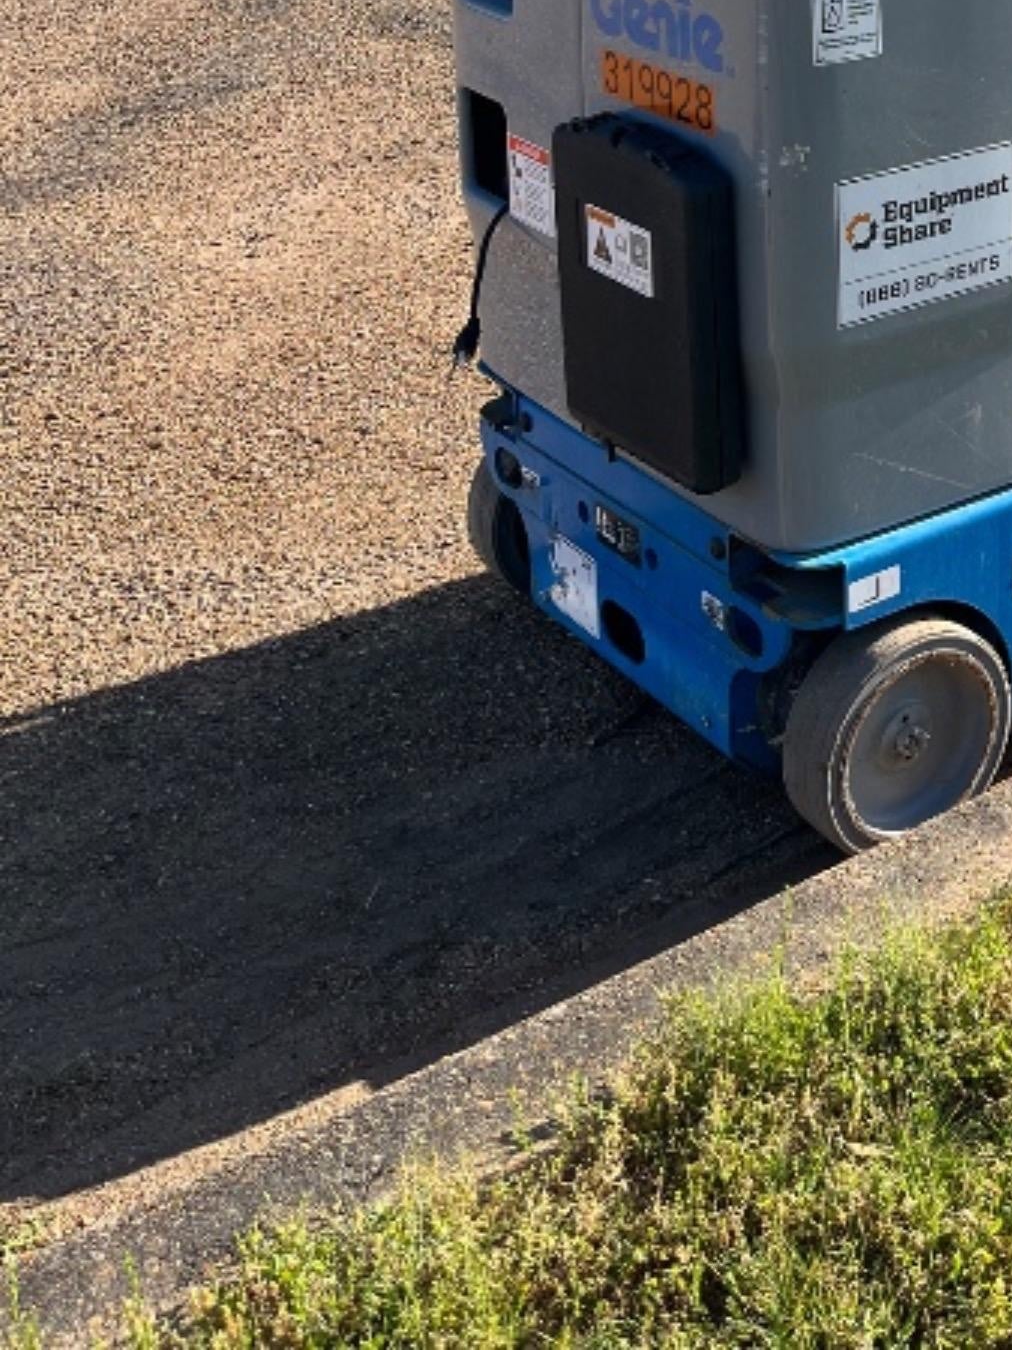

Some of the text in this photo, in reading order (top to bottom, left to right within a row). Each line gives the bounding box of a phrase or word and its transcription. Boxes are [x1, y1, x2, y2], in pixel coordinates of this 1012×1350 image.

[604, 50, 713, 130] 319928
[882, 173, 1009, 223] Equipment
[882, 218, 952, 249] Share
